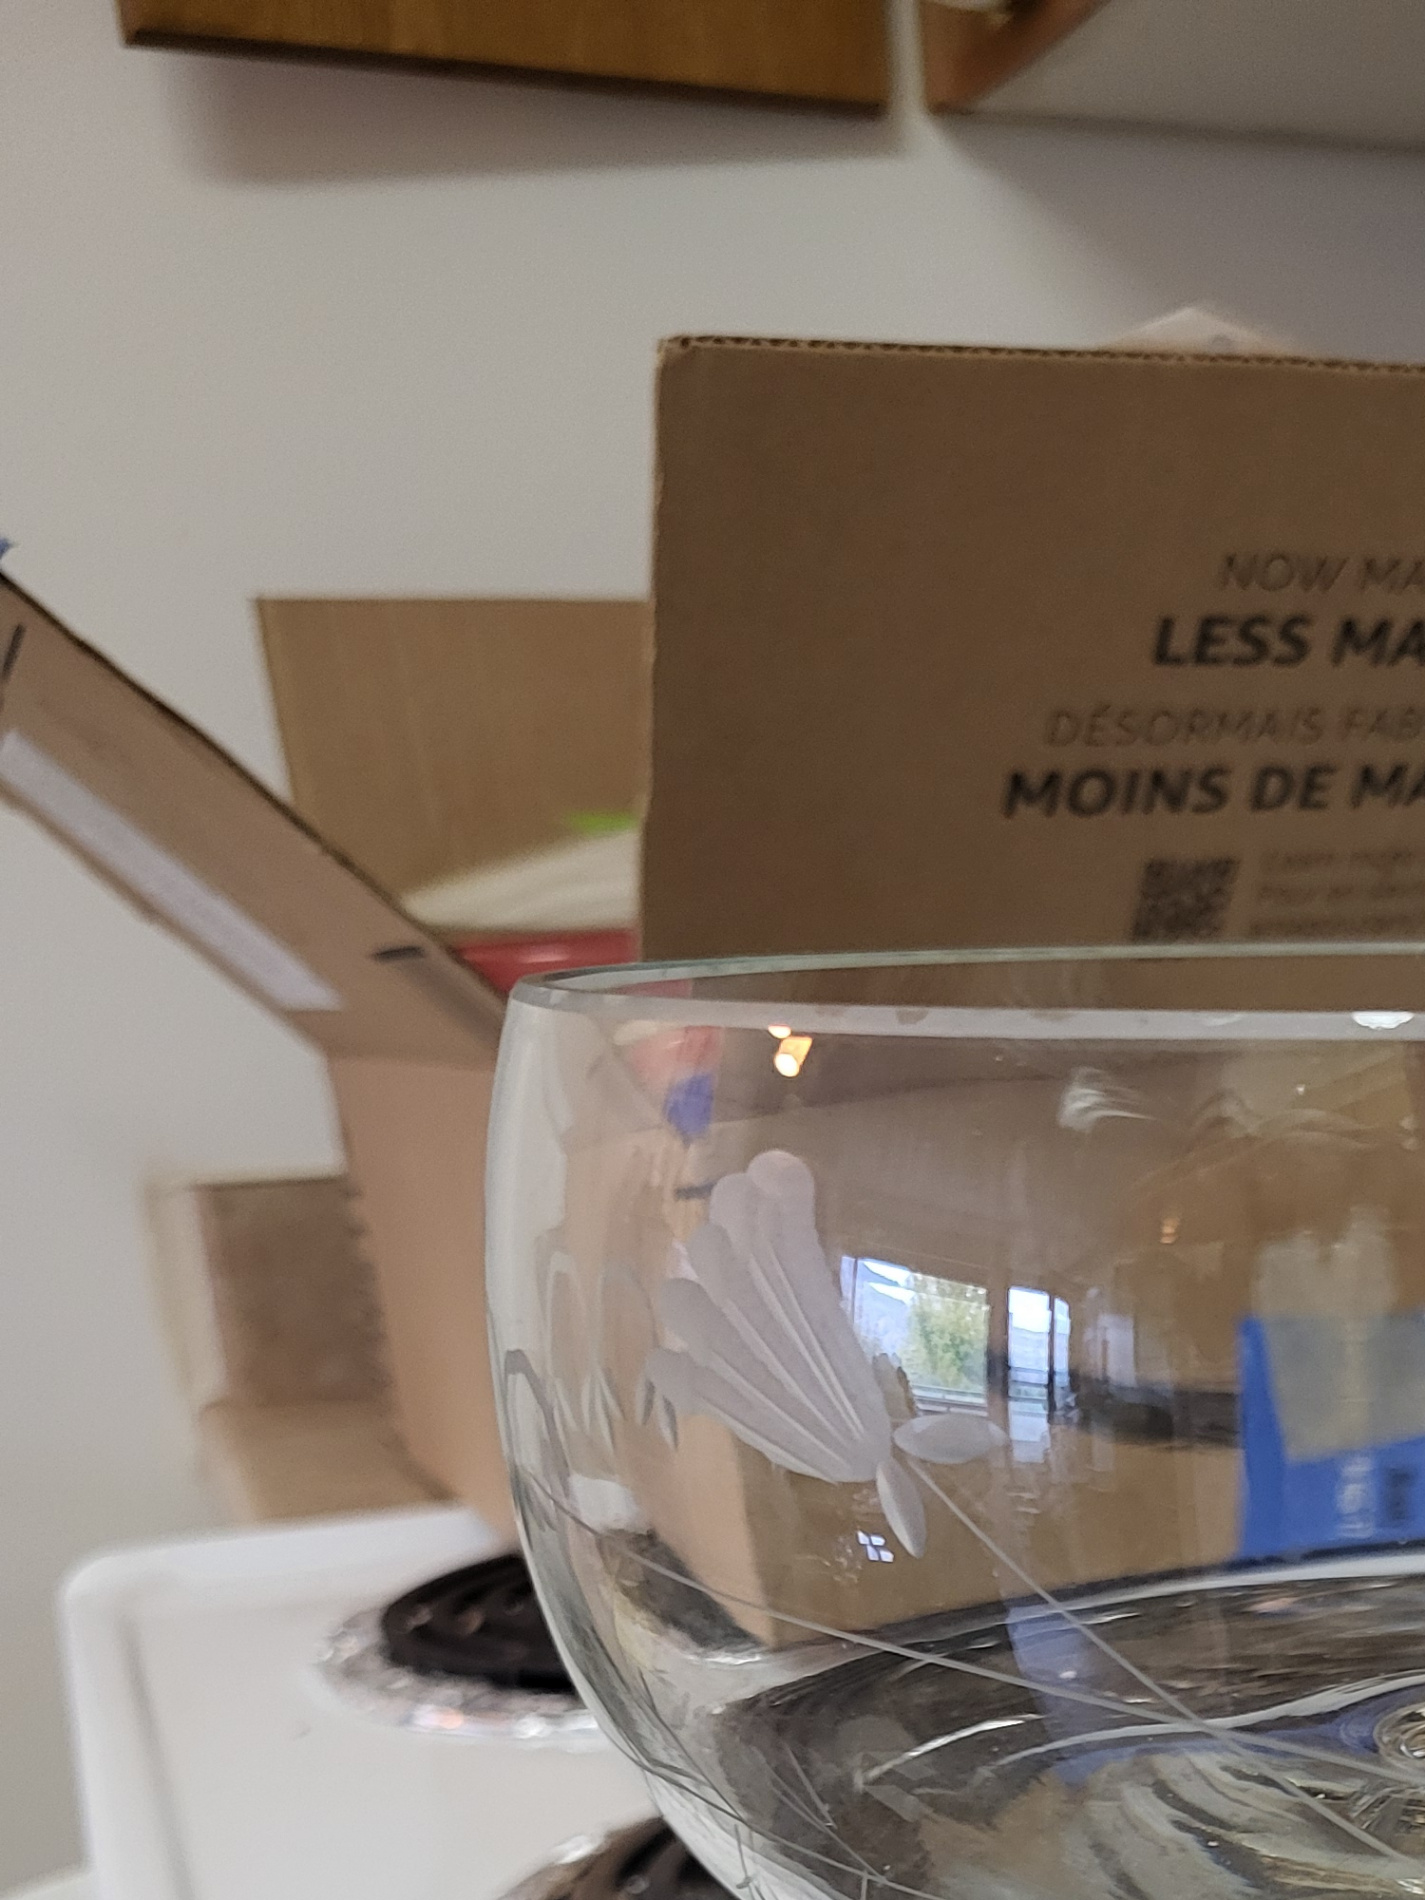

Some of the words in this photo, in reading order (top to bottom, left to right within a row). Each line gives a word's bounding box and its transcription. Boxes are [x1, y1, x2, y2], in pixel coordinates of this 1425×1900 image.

[1216, 552, 1350, 593] NOW
[1151, 613, 1315, 667] LESS
[1043, 701, 1326, 748] DÉSORMAIS
[1001, 763, 1232, 819] MOINS
[1248, 762, 1338, 813] DE
